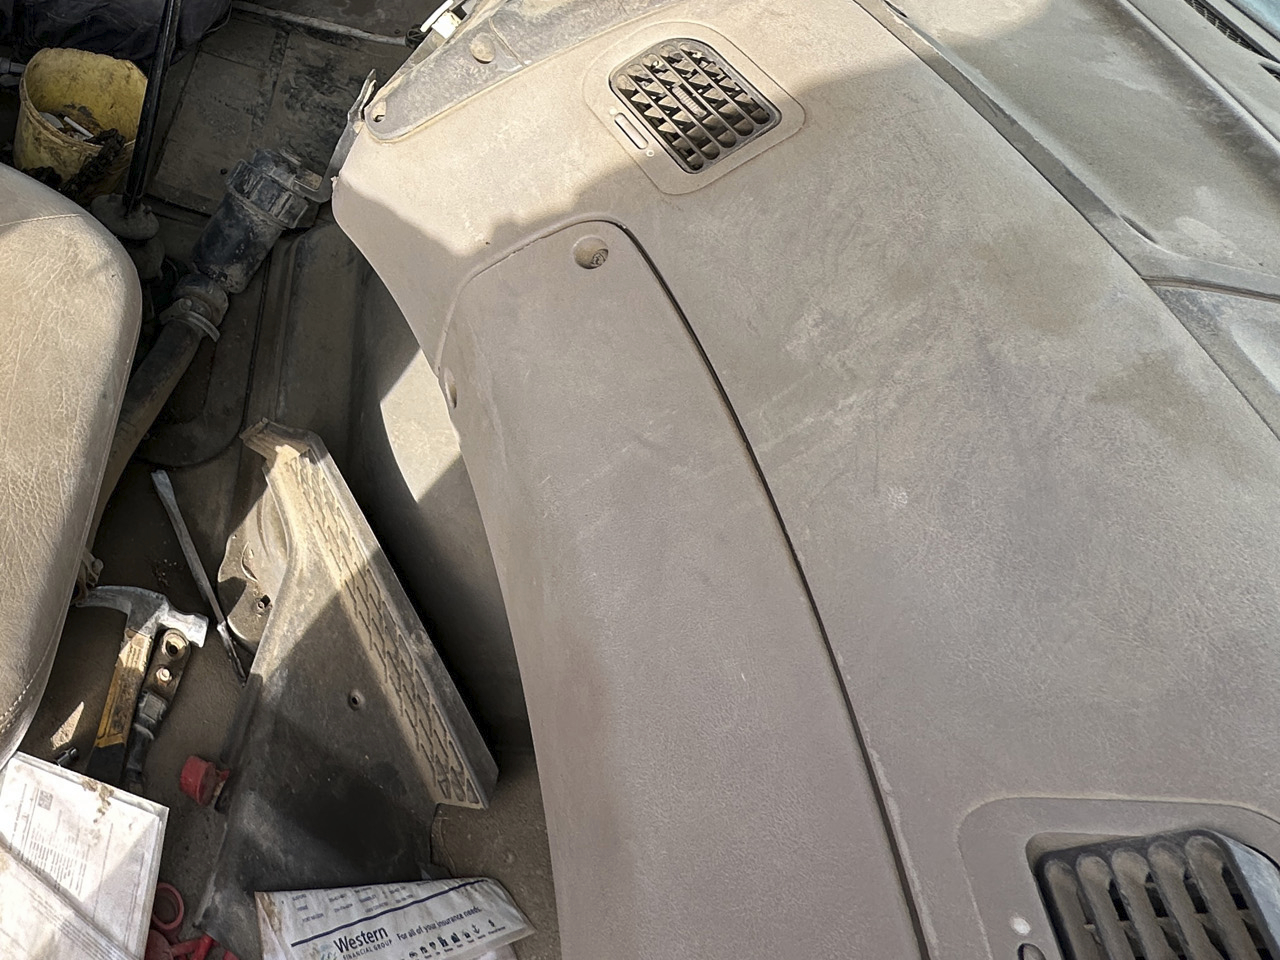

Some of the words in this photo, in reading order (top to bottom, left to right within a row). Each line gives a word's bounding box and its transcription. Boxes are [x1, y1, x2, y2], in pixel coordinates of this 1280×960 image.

[333, 927, 389, 954] Western
[397, 932, 408, 941] For
[408, 928, 417, 939] all
[416, 925, 424, 935] of
[424, 922, 437, 933] your
[437, 913, 464, 928] insurance
[343, 946, 373, 960] FINANCIAL
[373, 939, 393, 951] GROUP
